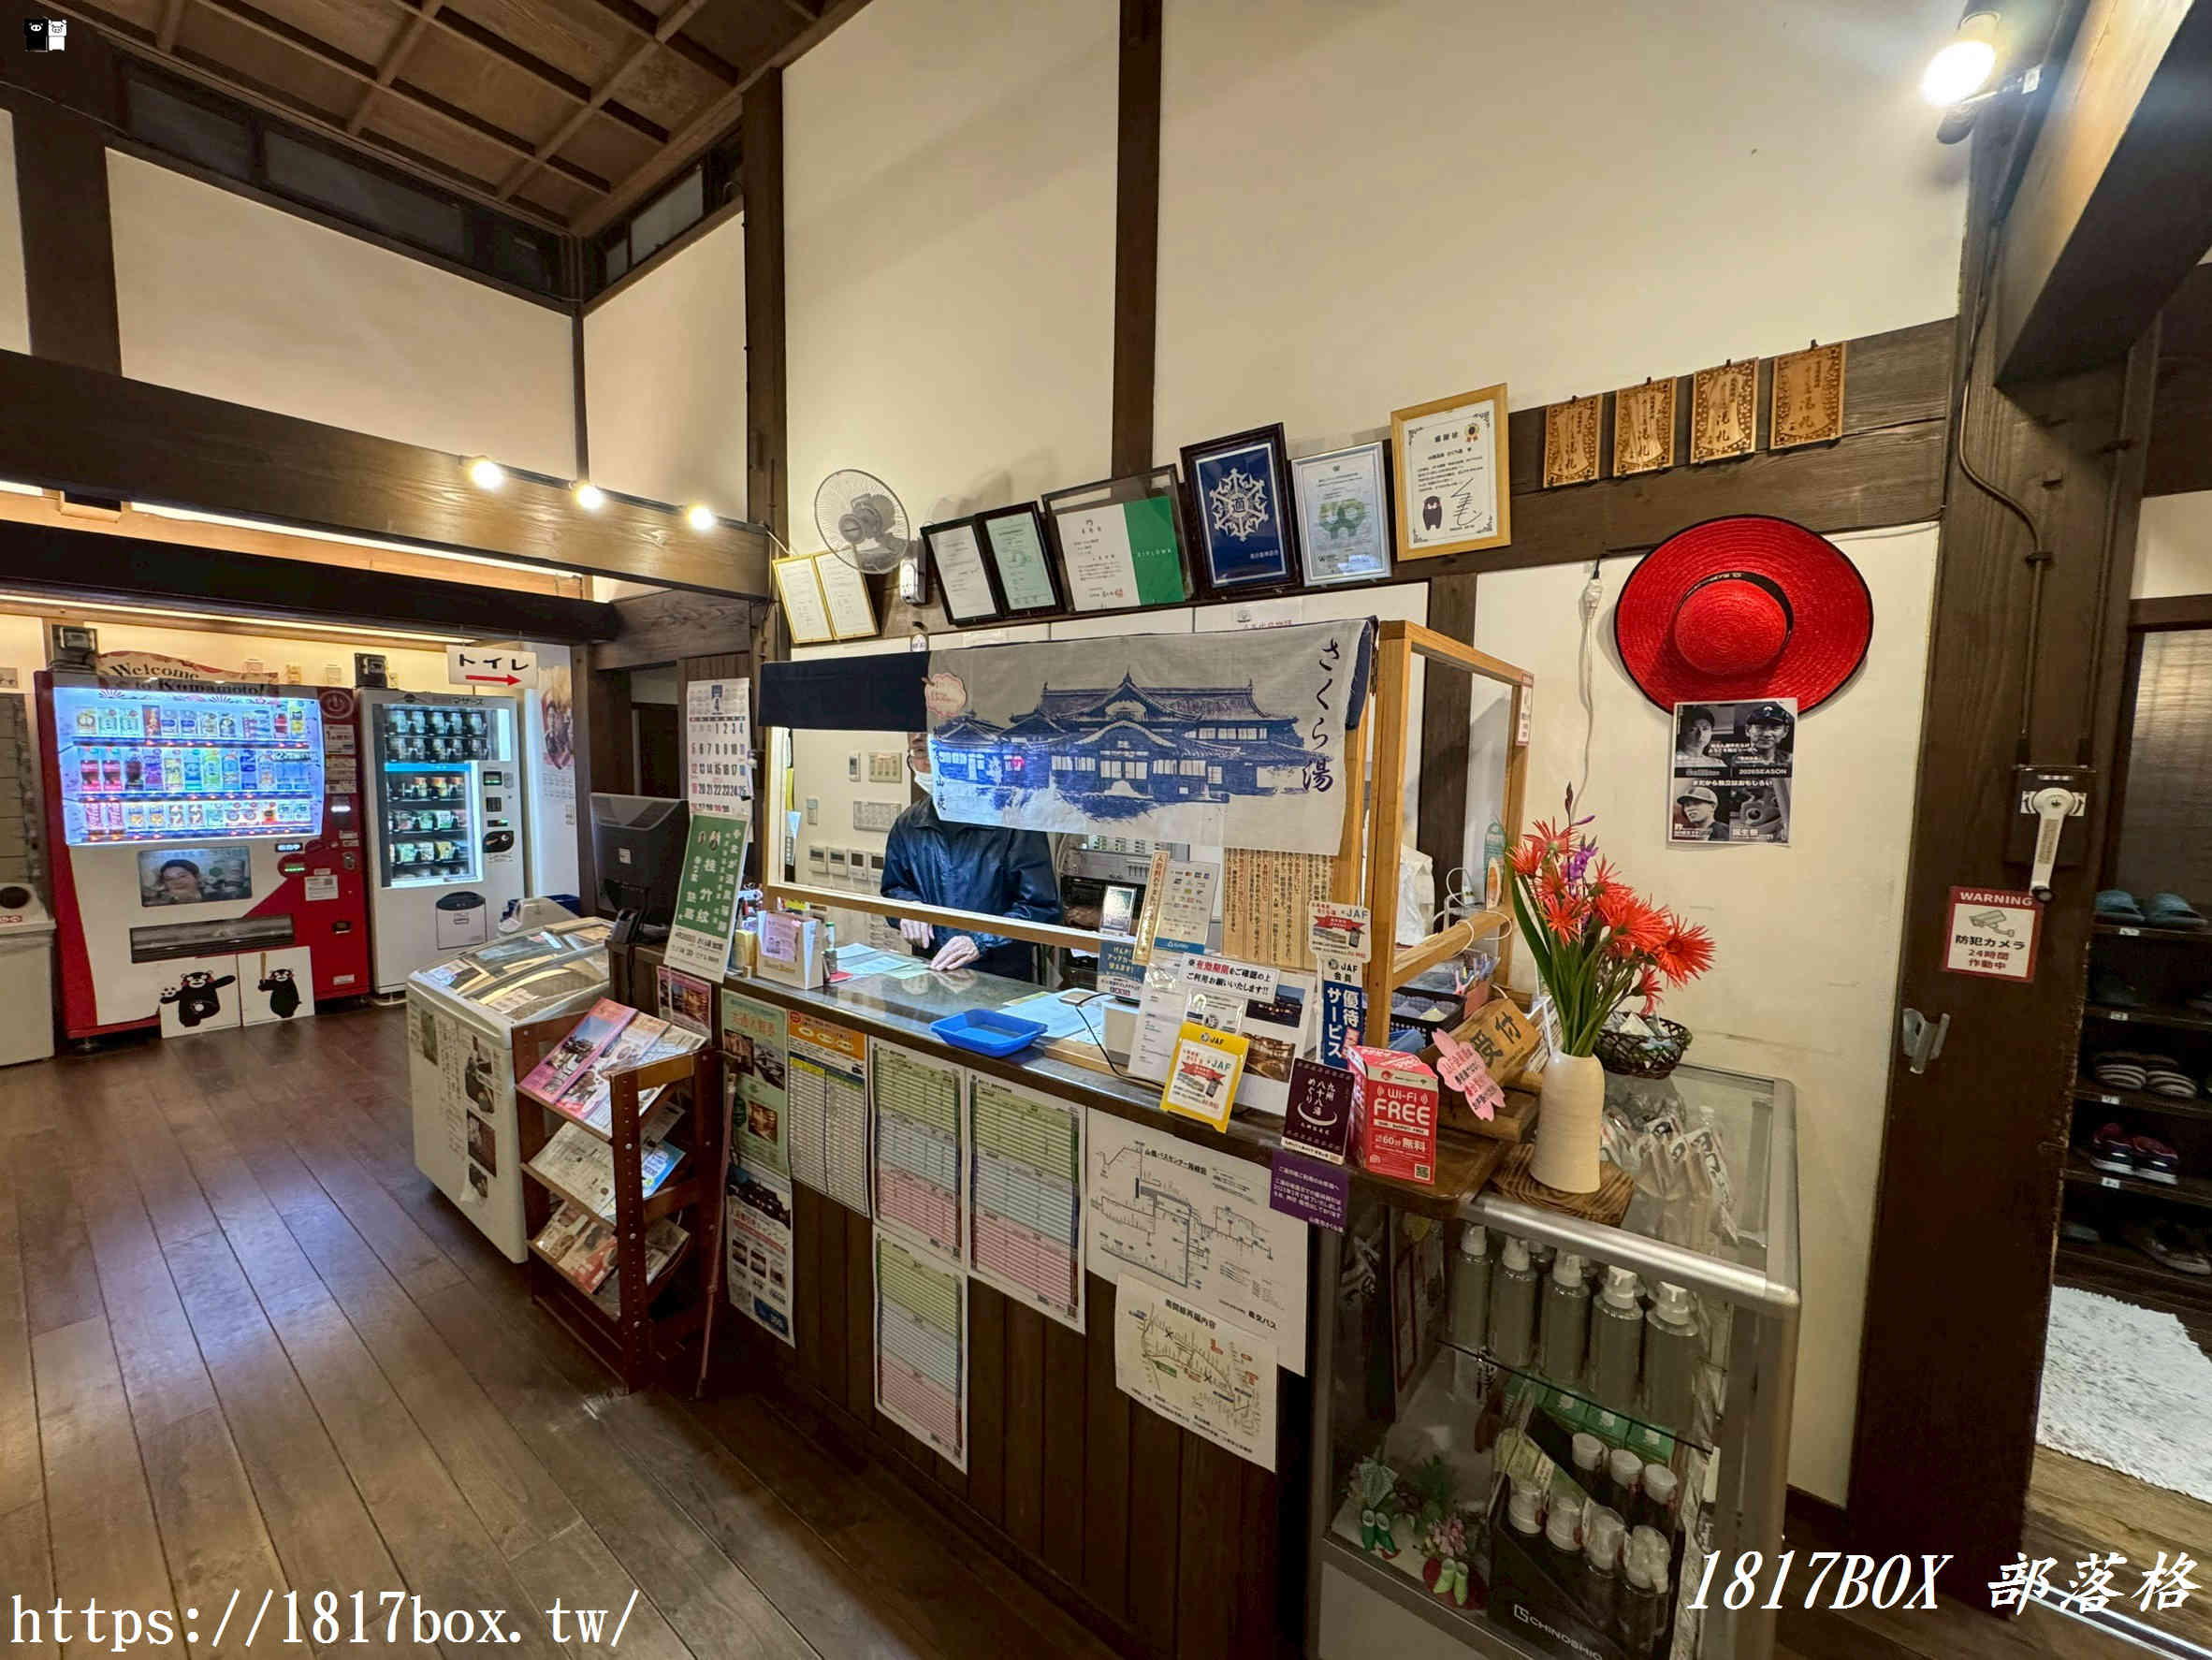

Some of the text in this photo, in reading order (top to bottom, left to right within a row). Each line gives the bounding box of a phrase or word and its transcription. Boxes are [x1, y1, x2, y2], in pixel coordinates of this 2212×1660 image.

[459, 653, 530, 671] トイレ
[110, 663, 199, 682] Welcome
[1302, 637, 1340, 793] さくら湯
[1959, 892, 2033, 906] WARNING
[1346, 909, 1368, 919] JAF
[1955, 934, 2026, 950] 防犯カメラ
[1968, 949, 2010, 961] 24時間
[1340, 963, 1359, 973] JAF
[1968, 959, 2006, 969] 作動中
[1333, 971, 1352, 983] 会員
[1327, 987, 1343, 1058] サービス
[1210, 1036, 1224, 1045] JAF
[1211, 1059, 1231, 1070] JAF
[1388, 1087, 1418, 1102] Wi-Fi
[1374, 1098, 1431, 1126] FREE
